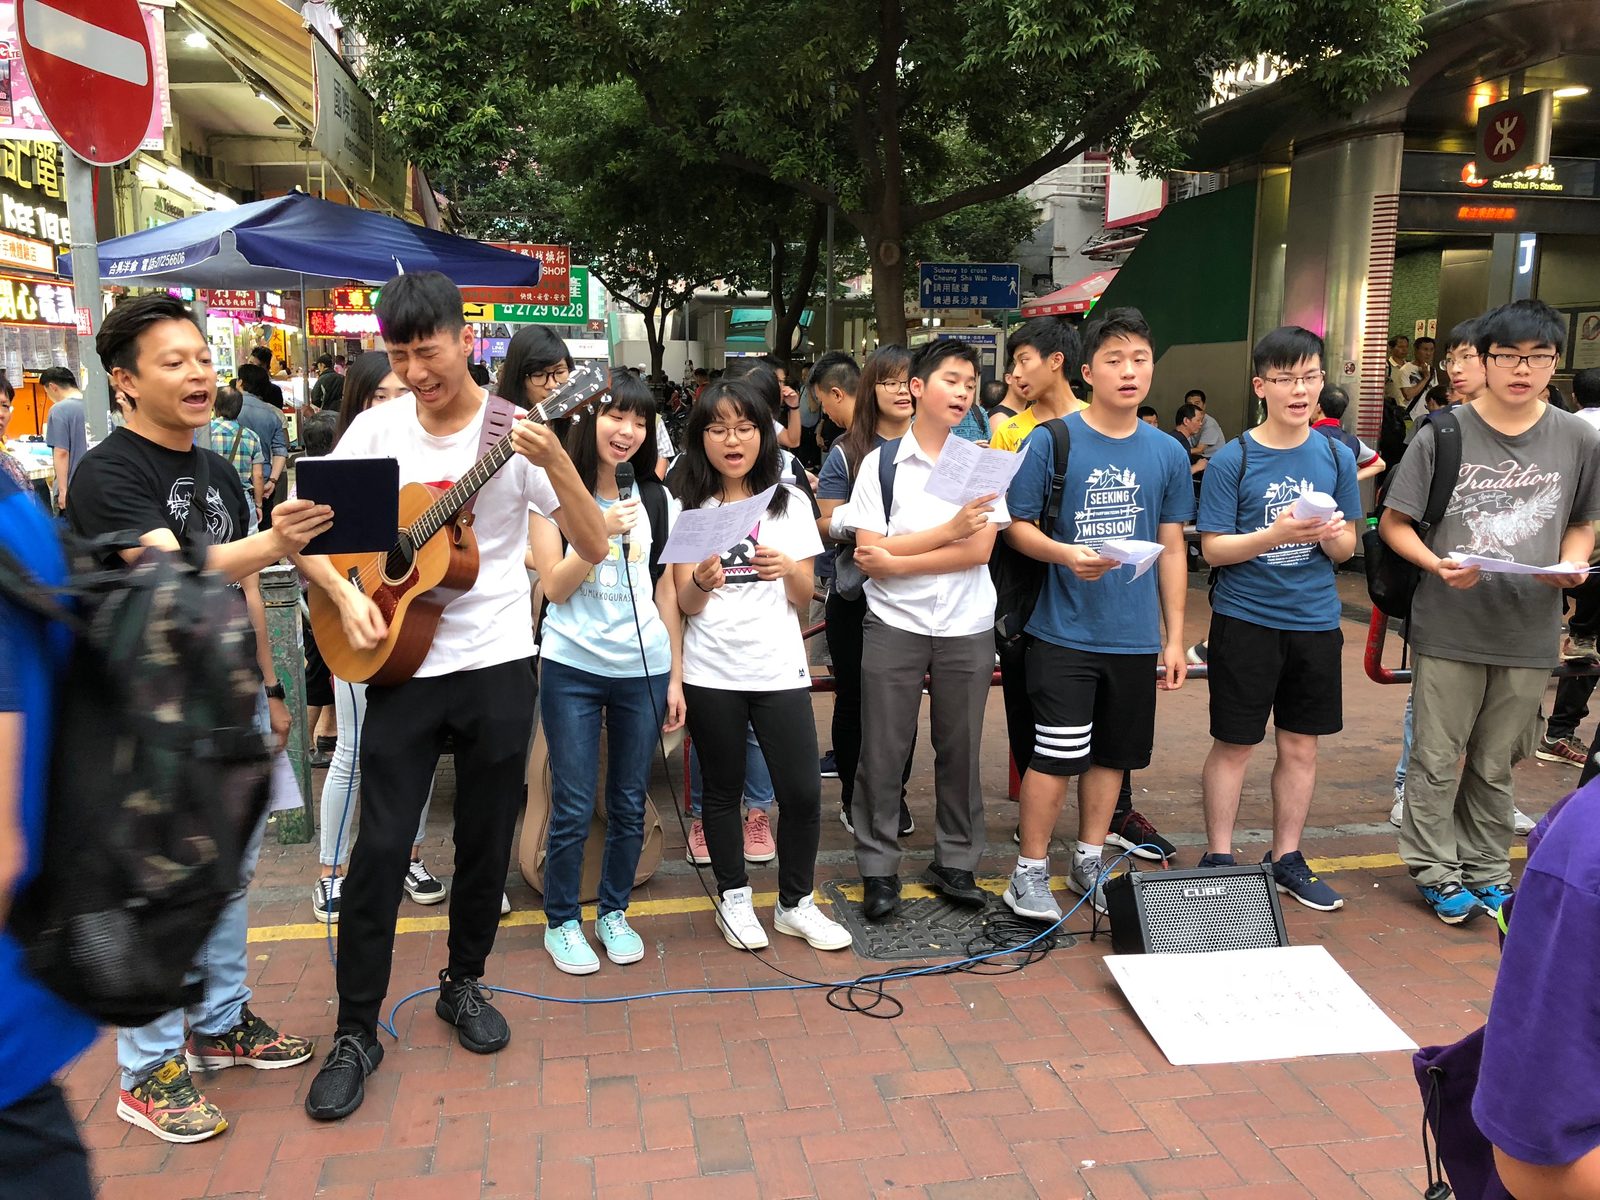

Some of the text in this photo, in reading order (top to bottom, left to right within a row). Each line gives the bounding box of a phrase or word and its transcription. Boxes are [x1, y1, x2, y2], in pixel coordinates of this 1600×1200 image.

[1492, 180, 1563, 191] Sham Shui Po Station
[2, 193, 37, 235] KEE
[1519, 239, 1536, 274] J
[542, 266, 567, 276] SHOP
[933, 267, 958, 275] Subway
[516, 303, 584, 317] 2729 6228
[1455, 459, 1562, 491] Tradition
[1090, 490, 1130, 505] SEEKING
[1082, 519, 1132, 537] MISSION
[1184, 886, 1228, 898] CUBE
